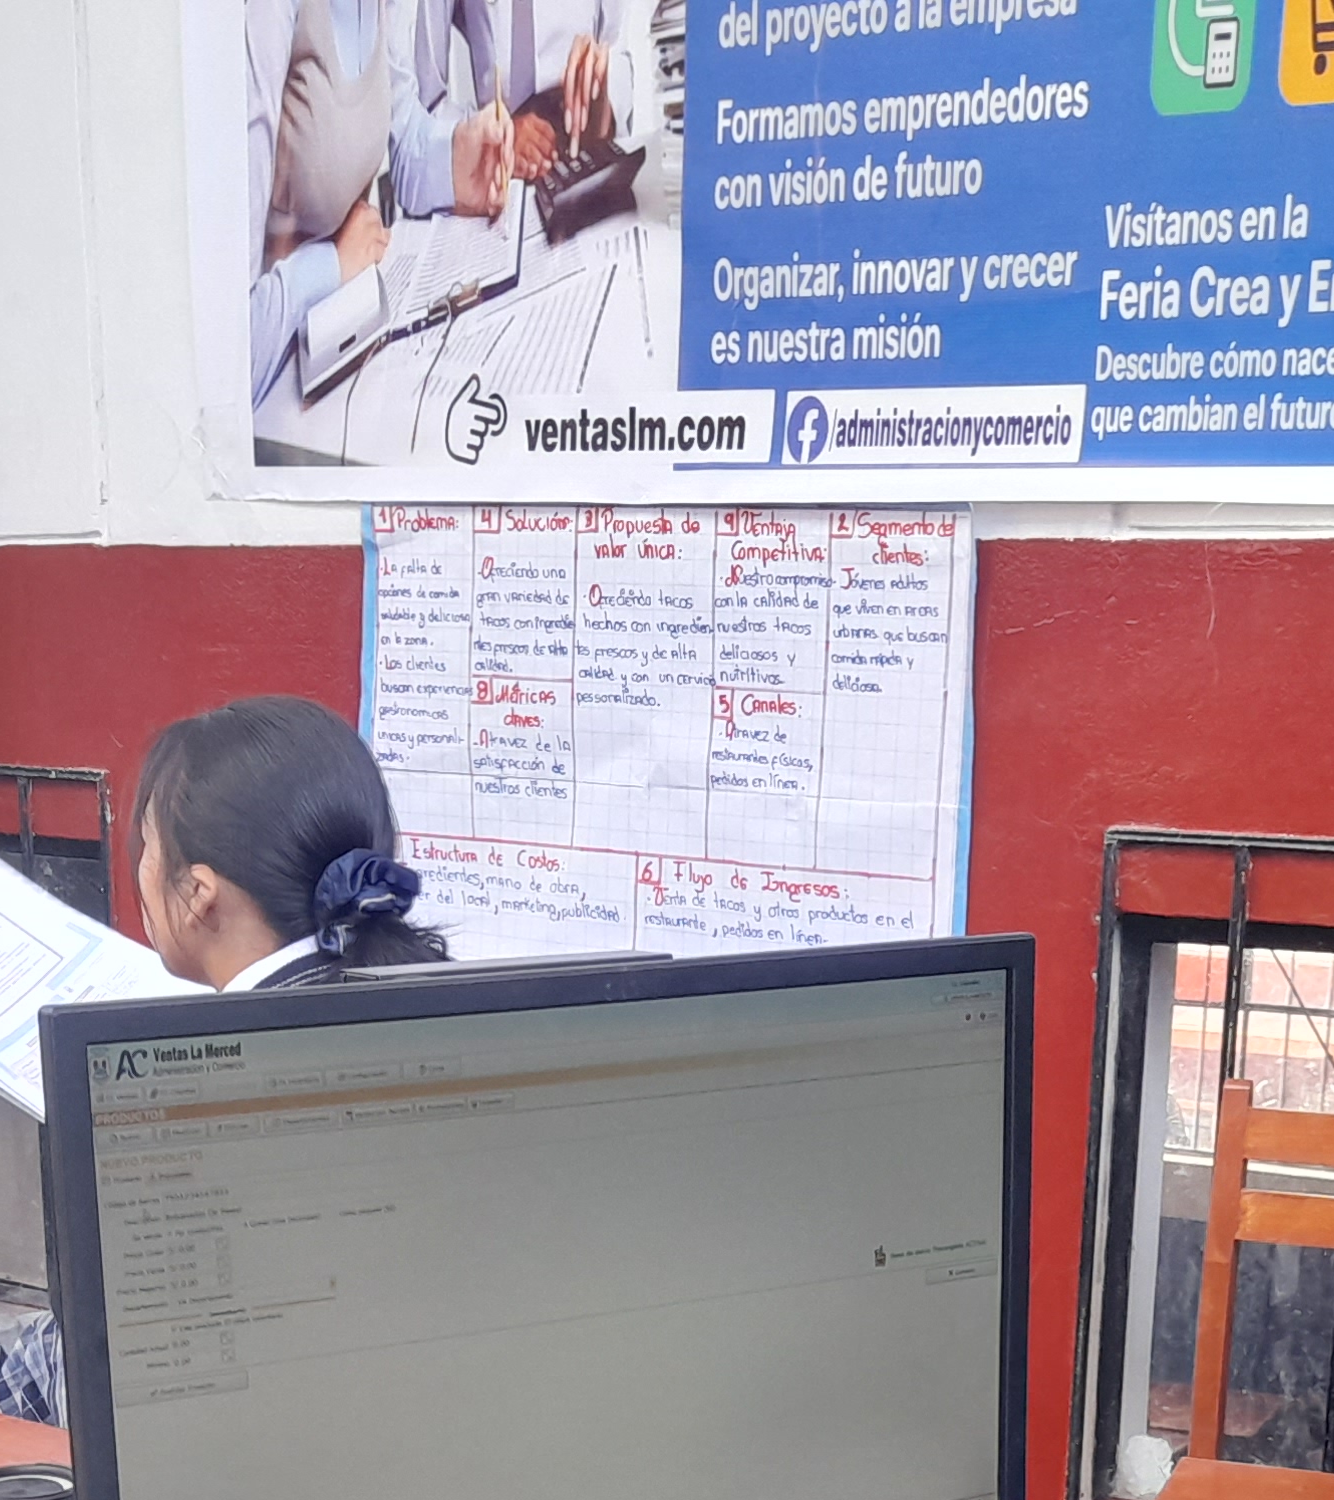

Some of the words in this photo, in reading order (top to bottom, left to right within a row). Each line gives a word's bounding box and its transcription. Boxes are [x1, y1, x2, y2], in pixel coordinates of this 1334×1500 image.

[719, 1, 758, 48] del
[766, 0, 888, 56] proyecto
[894, 1, 912, 32] a
[918, 0, 943, 29] la
[716, 97, 857, 145] Formamos
[864, 74, 1090, 141] emprendedores
[714, 173, 763, 210] con
[769, 157, 846, 207] visión
[853, 155, 888, 203] de
[895, 150, 983, 200] futuro
[1105, 201, 1233, 249] Visítanos
[1239, 206, 1275, 242] en
[1283, 193, 1309, 240] la
[713, 251, 845, 310] Organizar,
[852, 248, 955, 296] innovar
[958, 255, 978, 302] y
[983, 250, 1078, 290] crecer
[1099, 265, 1181, 321] Feria
[1189, 265, 1269, 318] Crea
[1278, 272, 1302, 328] y
[710, 330, 741, 364] es
[747, 321, 846, 363] nuestra
[852, 312, 941, 361] misión
[1094, 342, 1204, 382] Descubre
[1209, 341, 1275, 379] cómo
[525, 406, 746, 452] ventaslm.com
[1090, 402, 1133, 441] que
[1138, 394, 1236, 433] cambian
[1243, 392, 1266, 431] el
[594, 533, 627, 559] valor
[681, 512, 701, 534] de
[487, 846, 504, 867] de
[153, 1047, 188, 1062] Ventas
[190, 1045, 203, 1060] La
